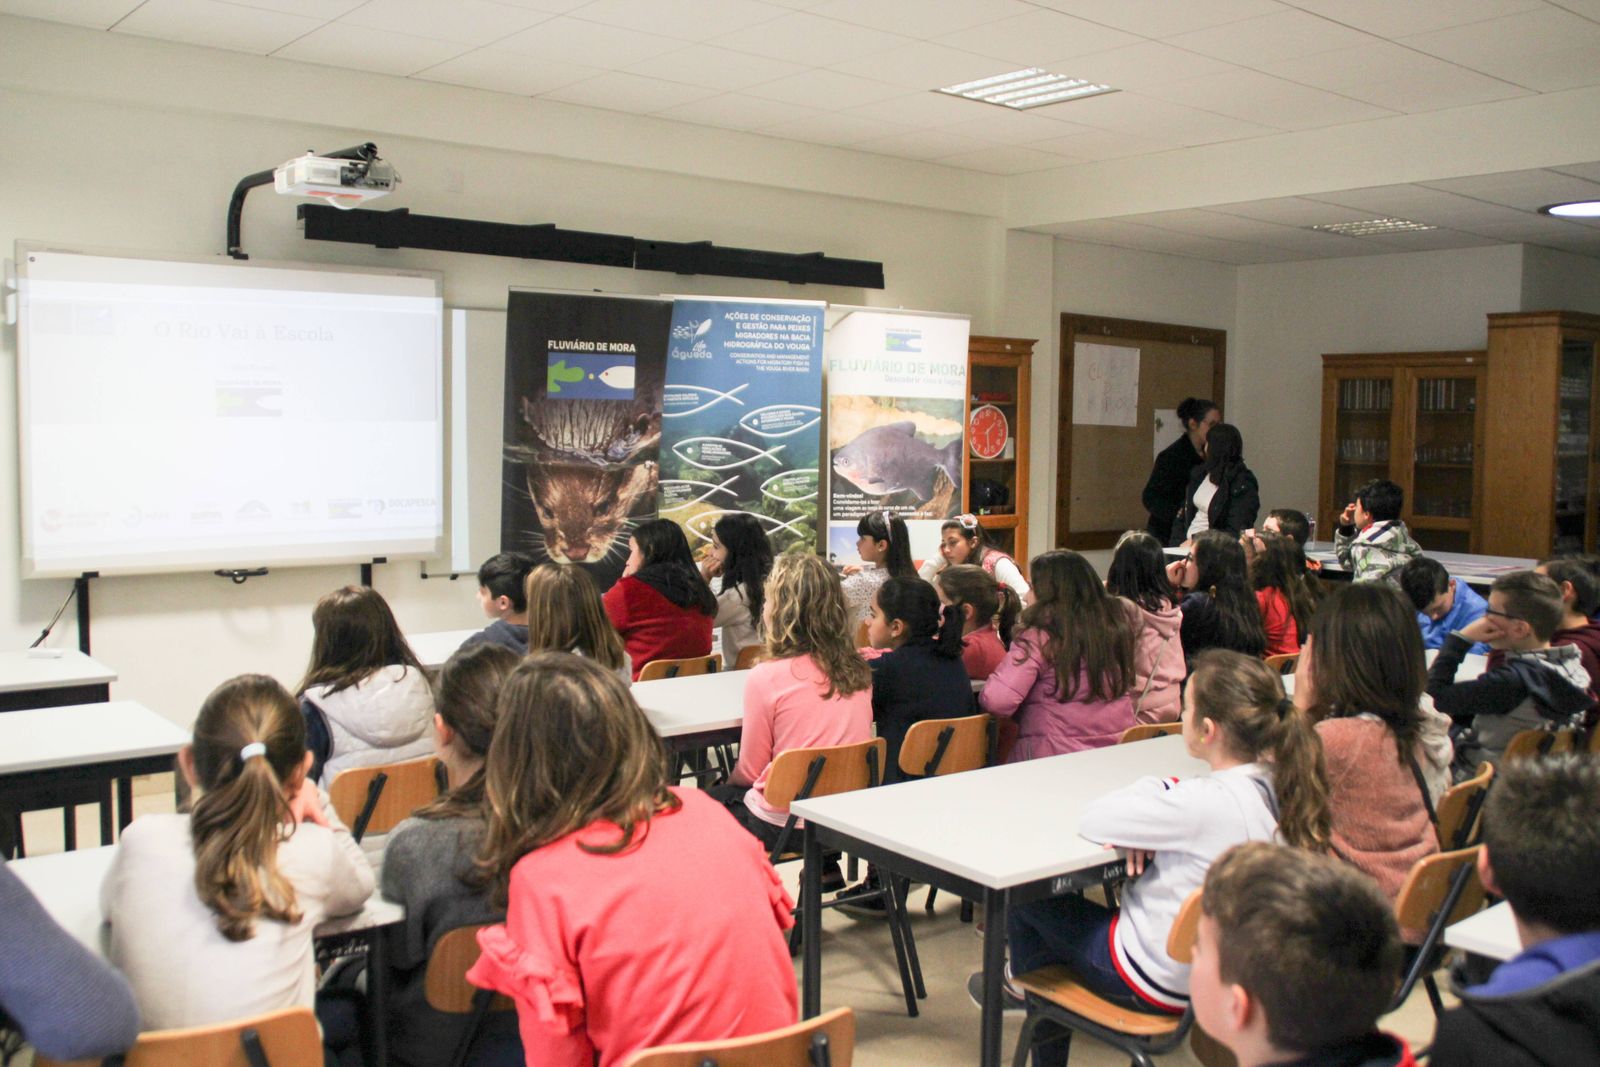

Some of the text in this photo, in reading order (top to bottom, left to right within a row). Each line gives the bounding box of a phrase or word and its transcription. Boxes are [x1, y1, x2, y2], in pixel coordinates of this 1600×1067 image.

[725, 312, 748, 320] AÇÕES
[761, 314, 811, 323] CONSERVAÇÃO
[154, 321, 170, 338] O
[178, 321, 212, 339] Rio
[217, 322, 248, 340] Vai
[272, 324, 336, 342] Escola
[548, 339, 636, 352] FLUVIÁRIO DE MORA
[724, 340, 772, 349] HIDROGRÁFICA
[908, 362, 925, 374] DE
[930, 363, 966, 376] MORA
